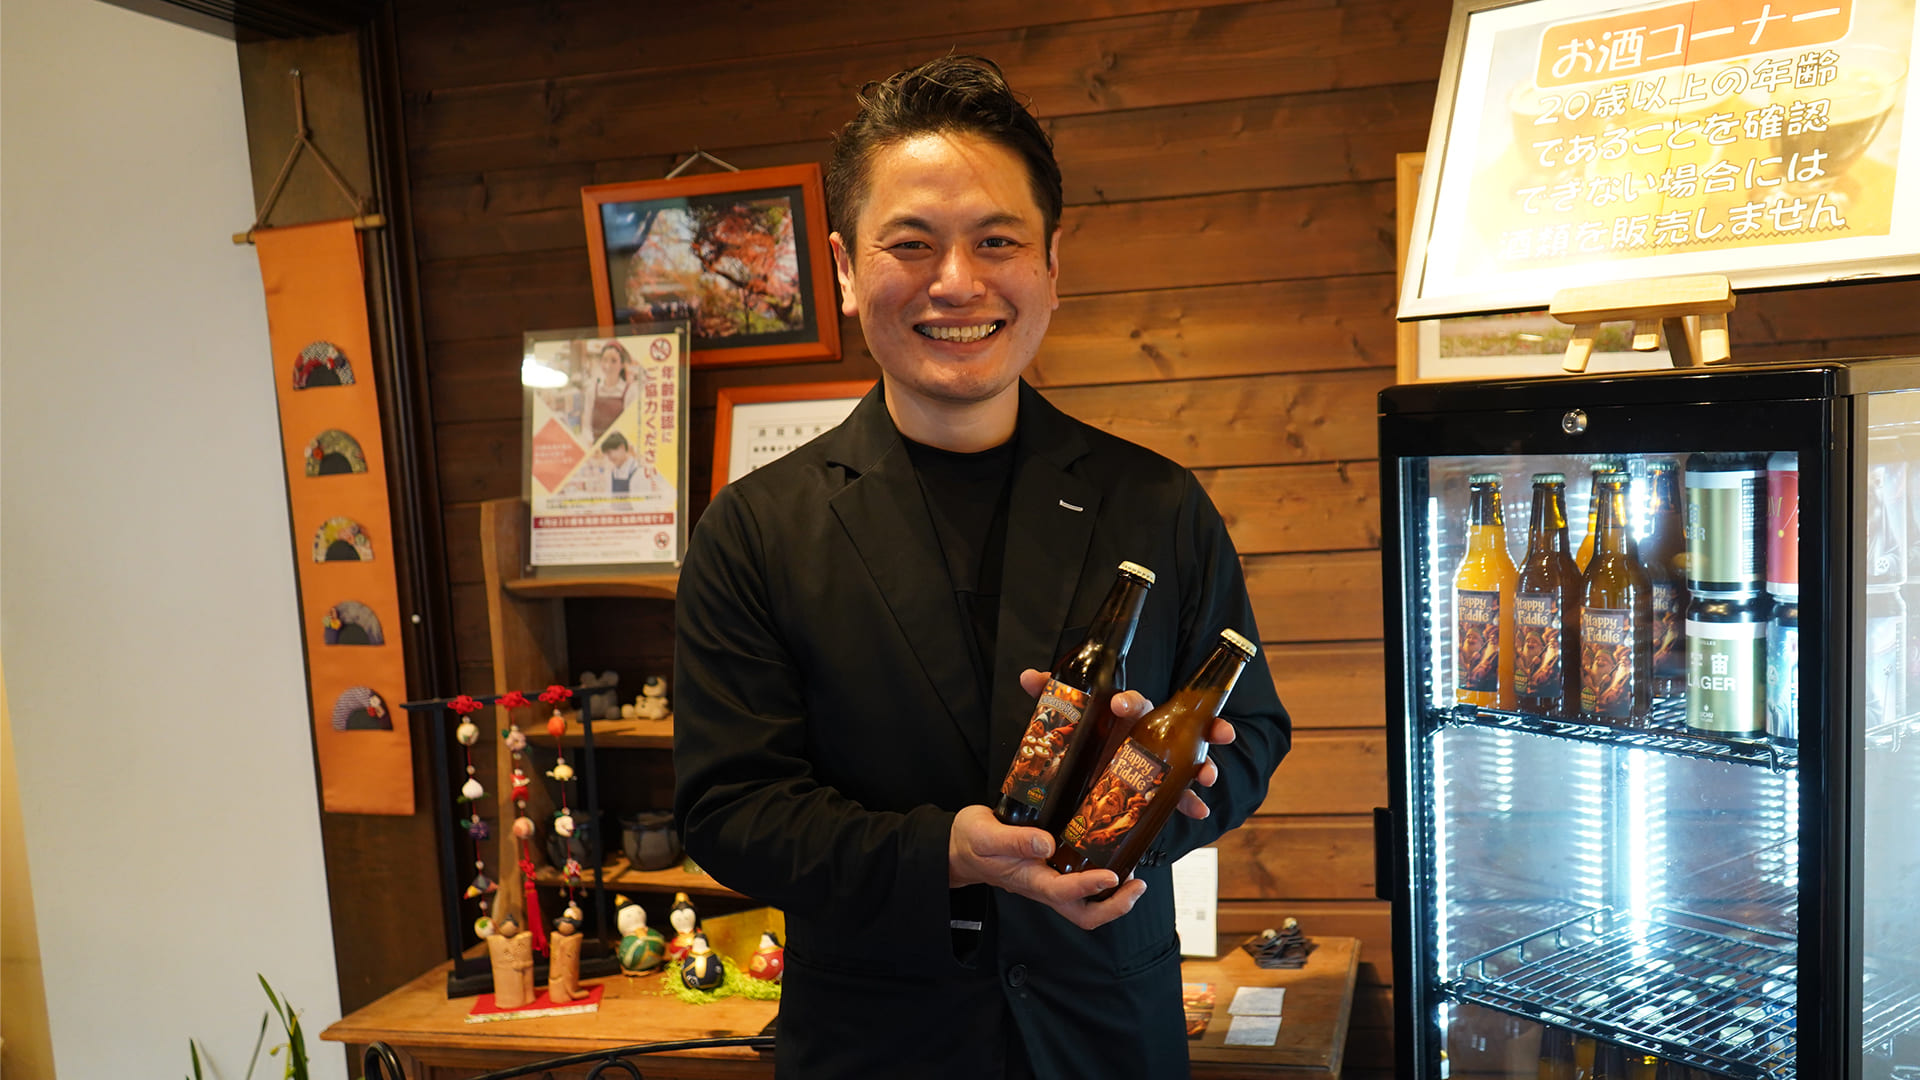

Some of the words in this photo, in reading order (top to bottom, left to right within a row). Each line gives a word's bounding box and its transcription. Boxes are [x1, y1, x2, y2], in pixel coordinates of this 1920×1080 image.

[1551, 4, 1841, 79] お酒コーナー
[1534, 50, 1840, 127] 20歳以上の年齢
[1532, 98, 1831, 168] であることを確認
[1517, 149, 1828, 214] できない場合には
[1500, 194, 1847, 261] 酒類を販売しません
[1515, 597, 1545, 612] Happy
[1517, 610, 1548, 626] Fiddle
[1584, 613, 1618, 630] Happy
[1586, 626, 1621, 643] Fiddle
[1688, 673, 1737, 691] LAGER
[1112, 758, 1147, 791] Fiddle
[1120, 744, 1155, 776] Happy
